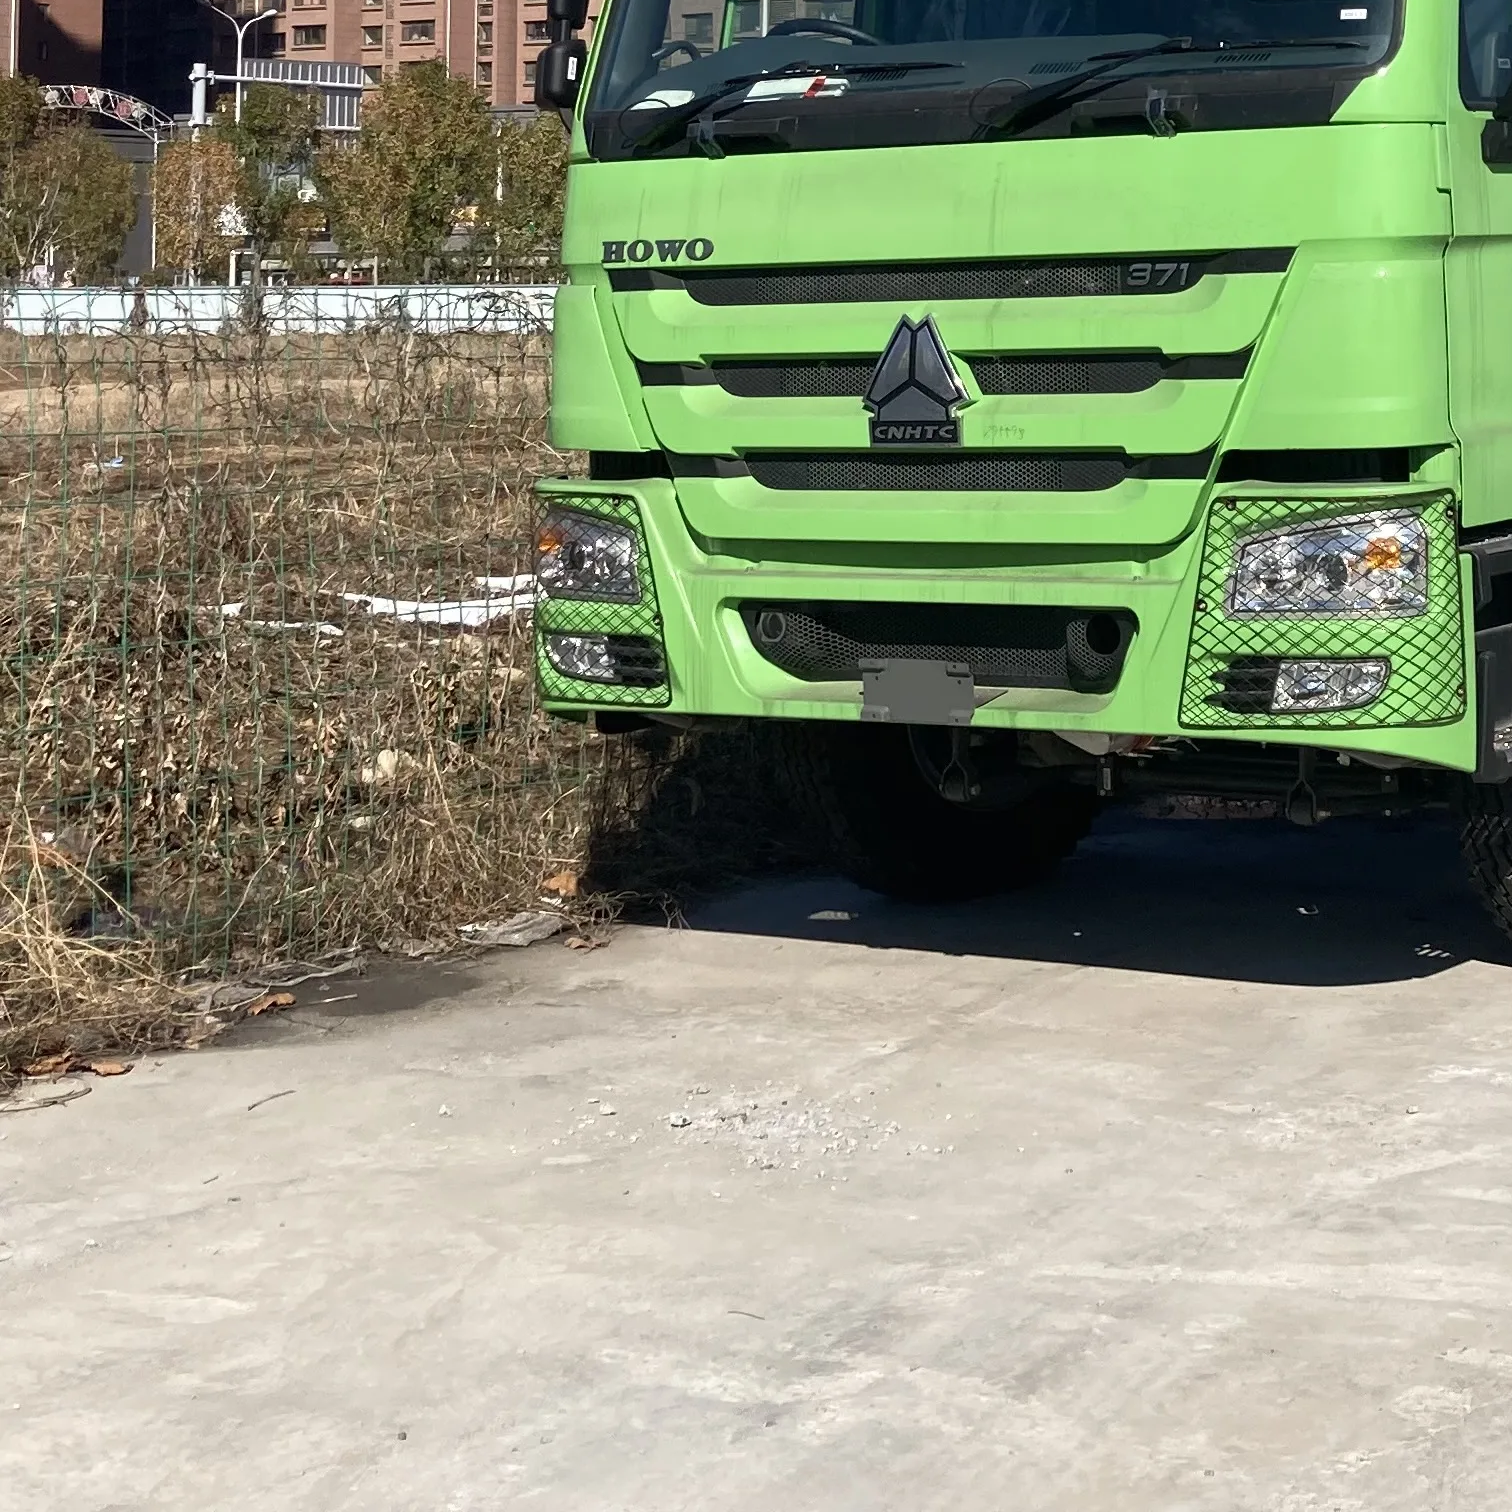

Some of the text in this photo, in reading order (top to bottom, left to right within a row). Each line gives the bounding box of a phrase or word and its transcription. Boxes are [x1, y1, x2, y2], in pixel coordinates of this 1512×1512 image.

[601, 238, 714, 263] HOWO
[1127, 262, 1190, 286] 371
[874, 424, 955, 440] CNHTC
